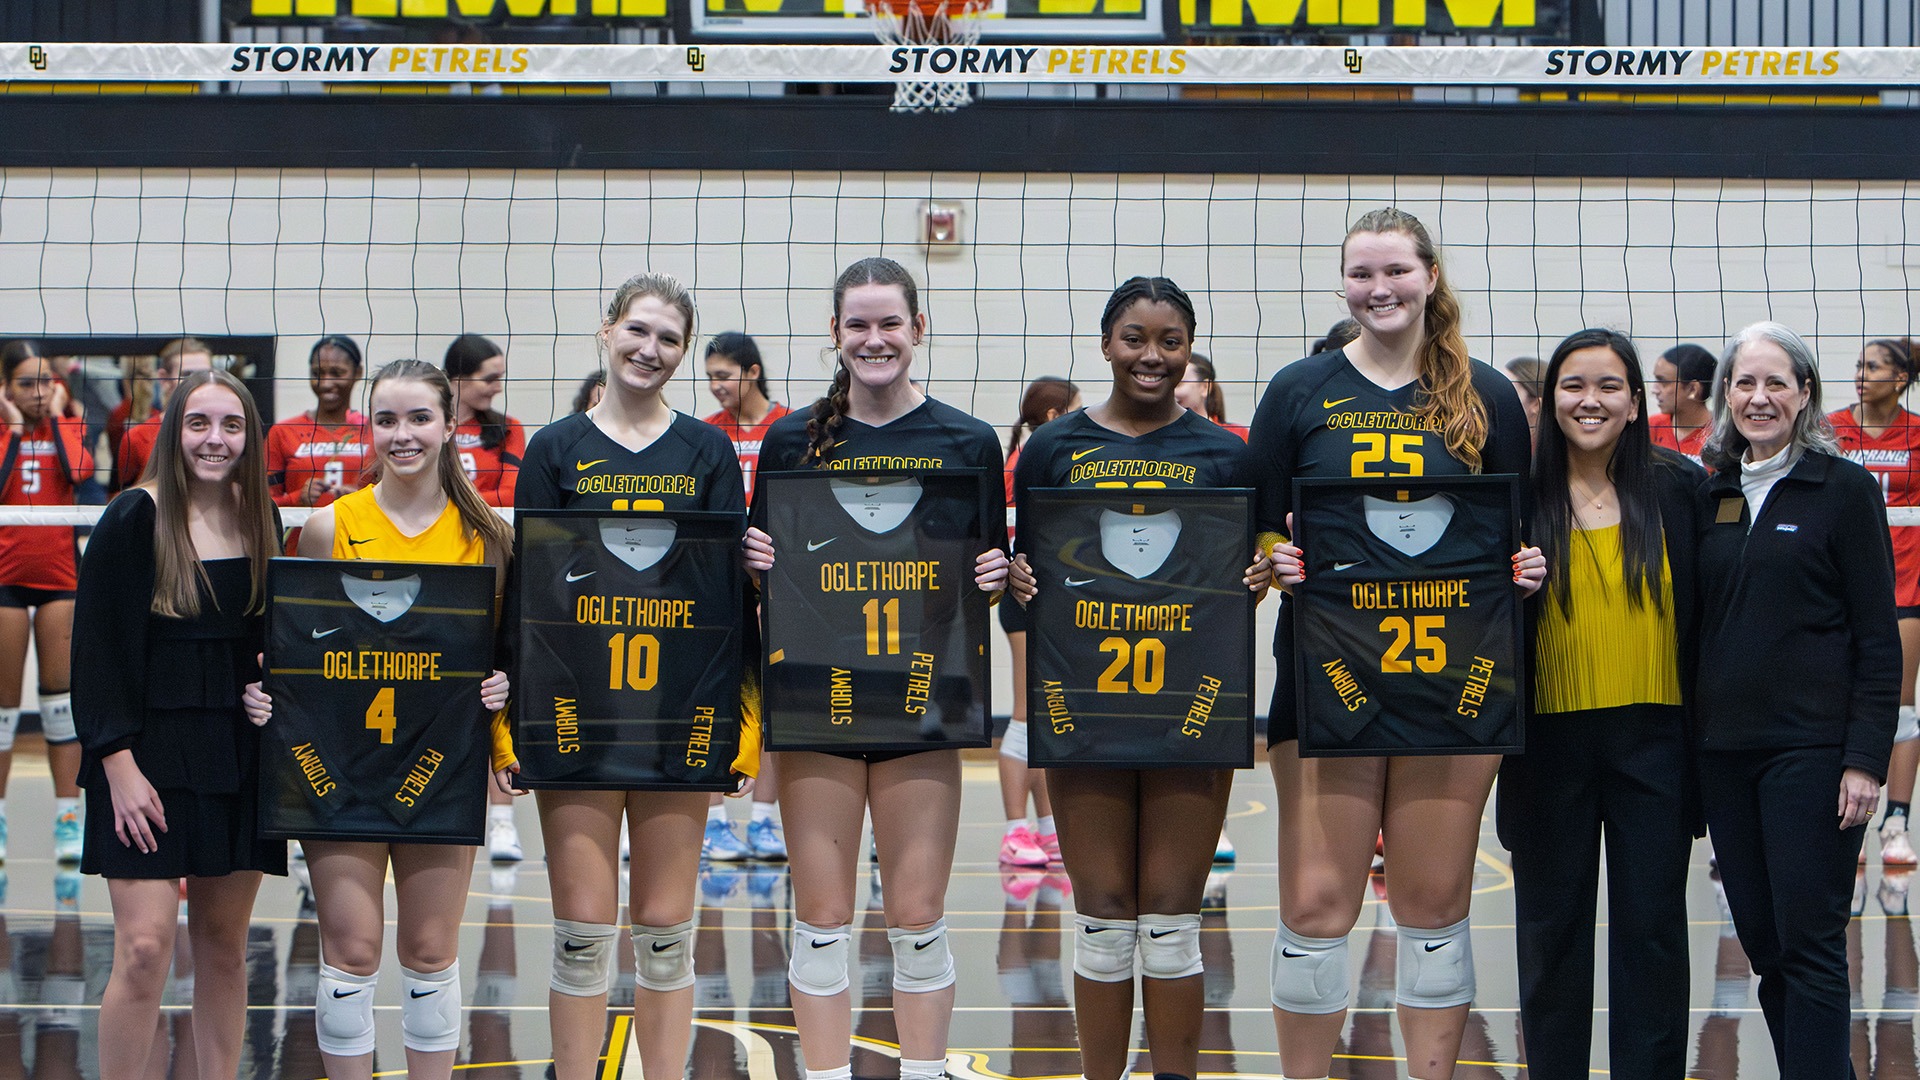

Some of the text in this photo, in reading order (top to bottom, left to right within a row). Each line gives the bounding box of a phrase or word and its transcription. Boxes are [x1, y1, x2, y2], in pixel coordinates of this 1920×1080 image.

[231, 46, 529, 74] STORMY PETRELS
[888, 47, 1187, 75] STORMY PETRELS
[1545, 50, 1840, 76] STORMY PETRELS
[21, 459, 41, 494] 5
[1070, 458, 1197, 484] OGLETHORPE
[1350, 432, 1425, 477] 25
[576, 474, 696, 496] OGLETHORPE
[820, 561, 940, 593] OGLETHORPE
[1351, 578, 1471, 610] OGLETHORPE
[576, 595, 696, 629] OGLETHORPE
[862, 597, 901, 656] 11
[1075, 599, 1193, 632] OGLETHORPE
[323, 650, 442, 681] OGLETHORPE
[607, 632, 661, 692] 10
[1096, 636, 1167, 695] 20
[1378, 614, 1447, 674] 25
[830, 667, 853, 725] STORMY
[904, 651, 935, 715] PETRELS
[1041, 679, 1075, 735] STORMY
[1181, 675, 1223, 739] PETRELS
[1321, 657, 1368, 712] STORMY
[1456, 655, 1496, 719] PETRELS
[365, 687, 397, 745] 4
[553, 696, 581, 754] STORMY
[685, 705, 715, 769] PETRELS
[291, 742, 338, 798] STORMY
[394, 748, 445, 808] PETRELS
